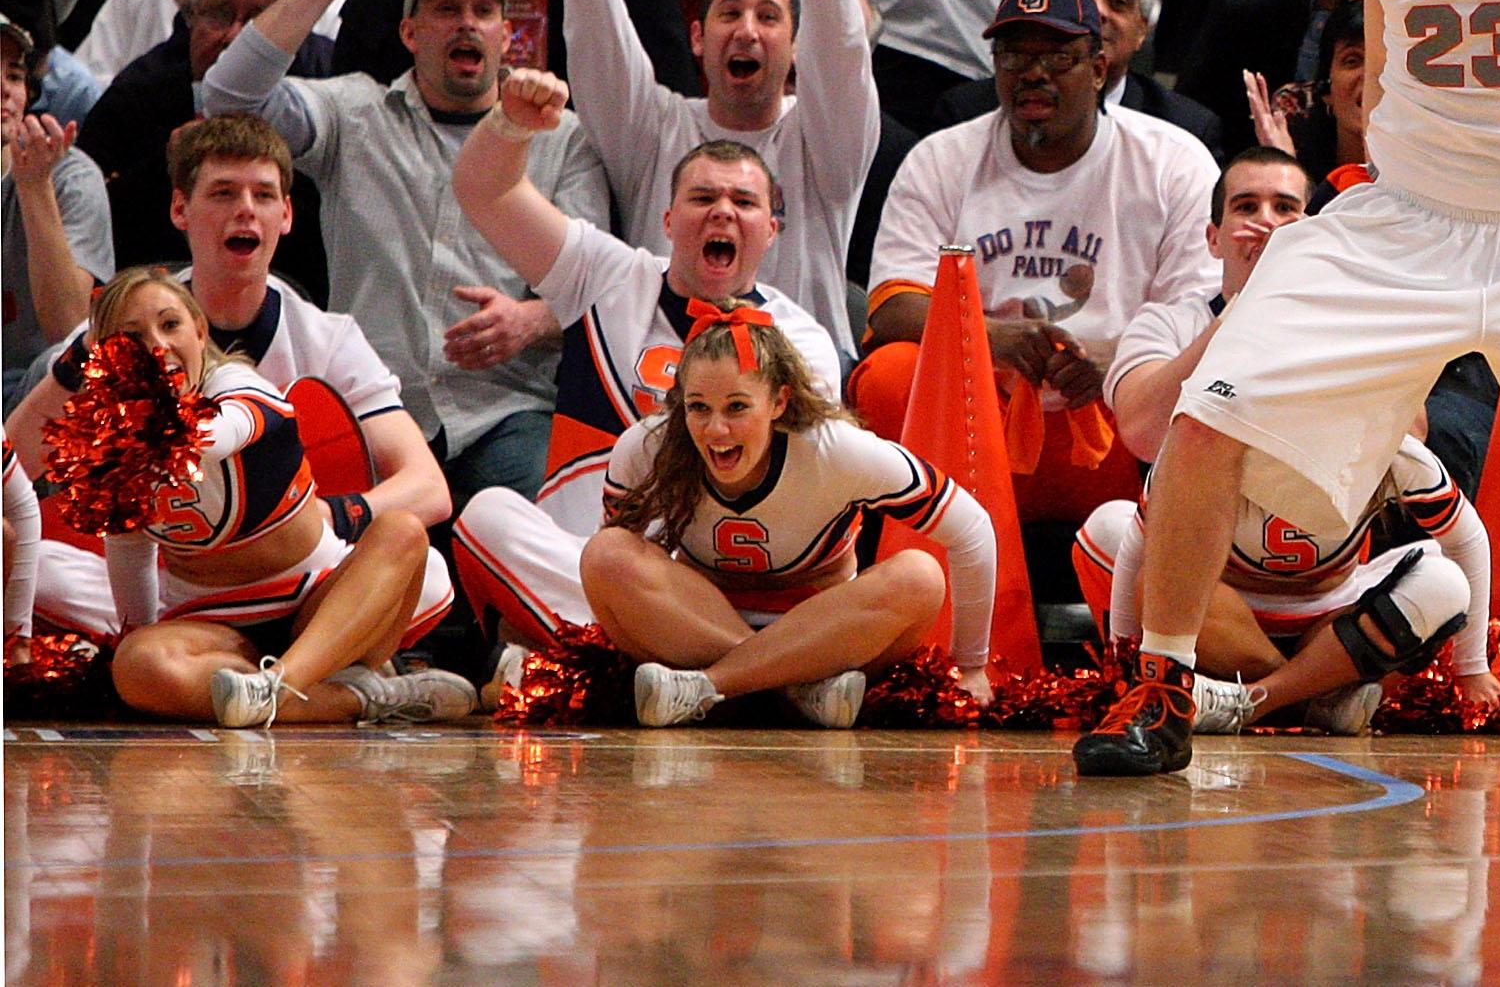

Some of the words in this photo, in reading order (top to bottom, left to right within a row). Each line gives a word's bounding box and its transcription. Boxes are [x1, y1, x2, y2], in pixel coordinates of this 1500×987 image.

[976, 227, 1013, 265] DO
[1024, 220, 1052, 249] IT
[1011, 255, 1069, 278] PAUL
[154, 478, 215, 542] S
[712, 516, 771, 572] S
[1261, 513, 1320, 572] S
